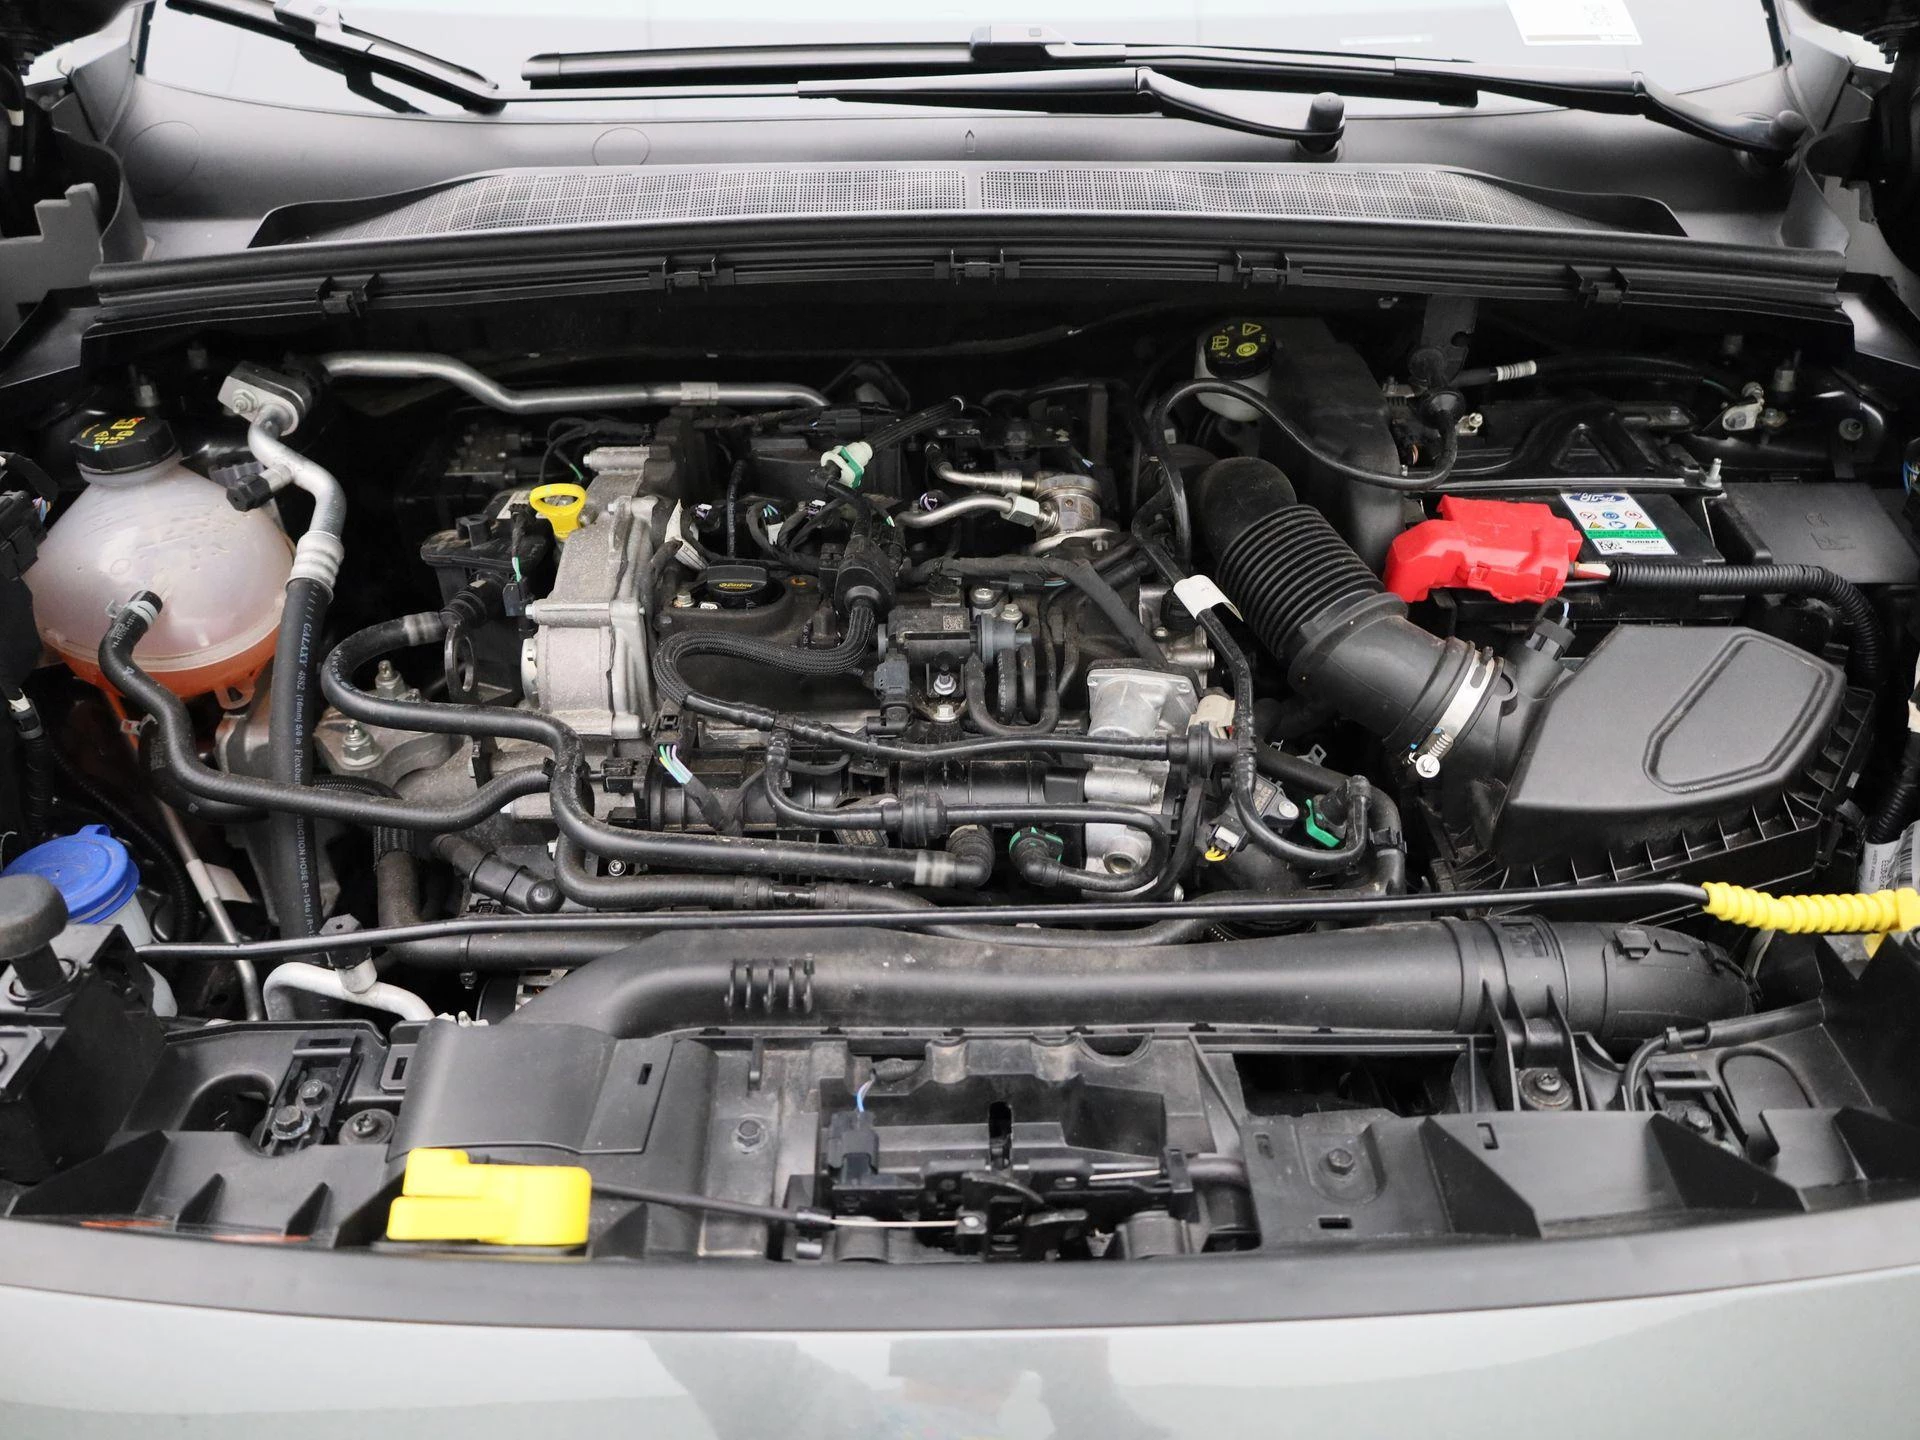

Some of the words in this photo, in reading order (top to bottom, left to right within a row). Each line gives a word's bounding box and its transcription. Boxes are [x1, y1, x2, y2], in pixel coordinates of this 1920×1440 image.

[1580, 492, 1616, 502] Ford
[300, 623, 312, 667] GALAXY
[297, 670, 306, 690] 4882
[297, 818, 305, 855] SUCTION
[300, 857, 309, 881] HOSE
